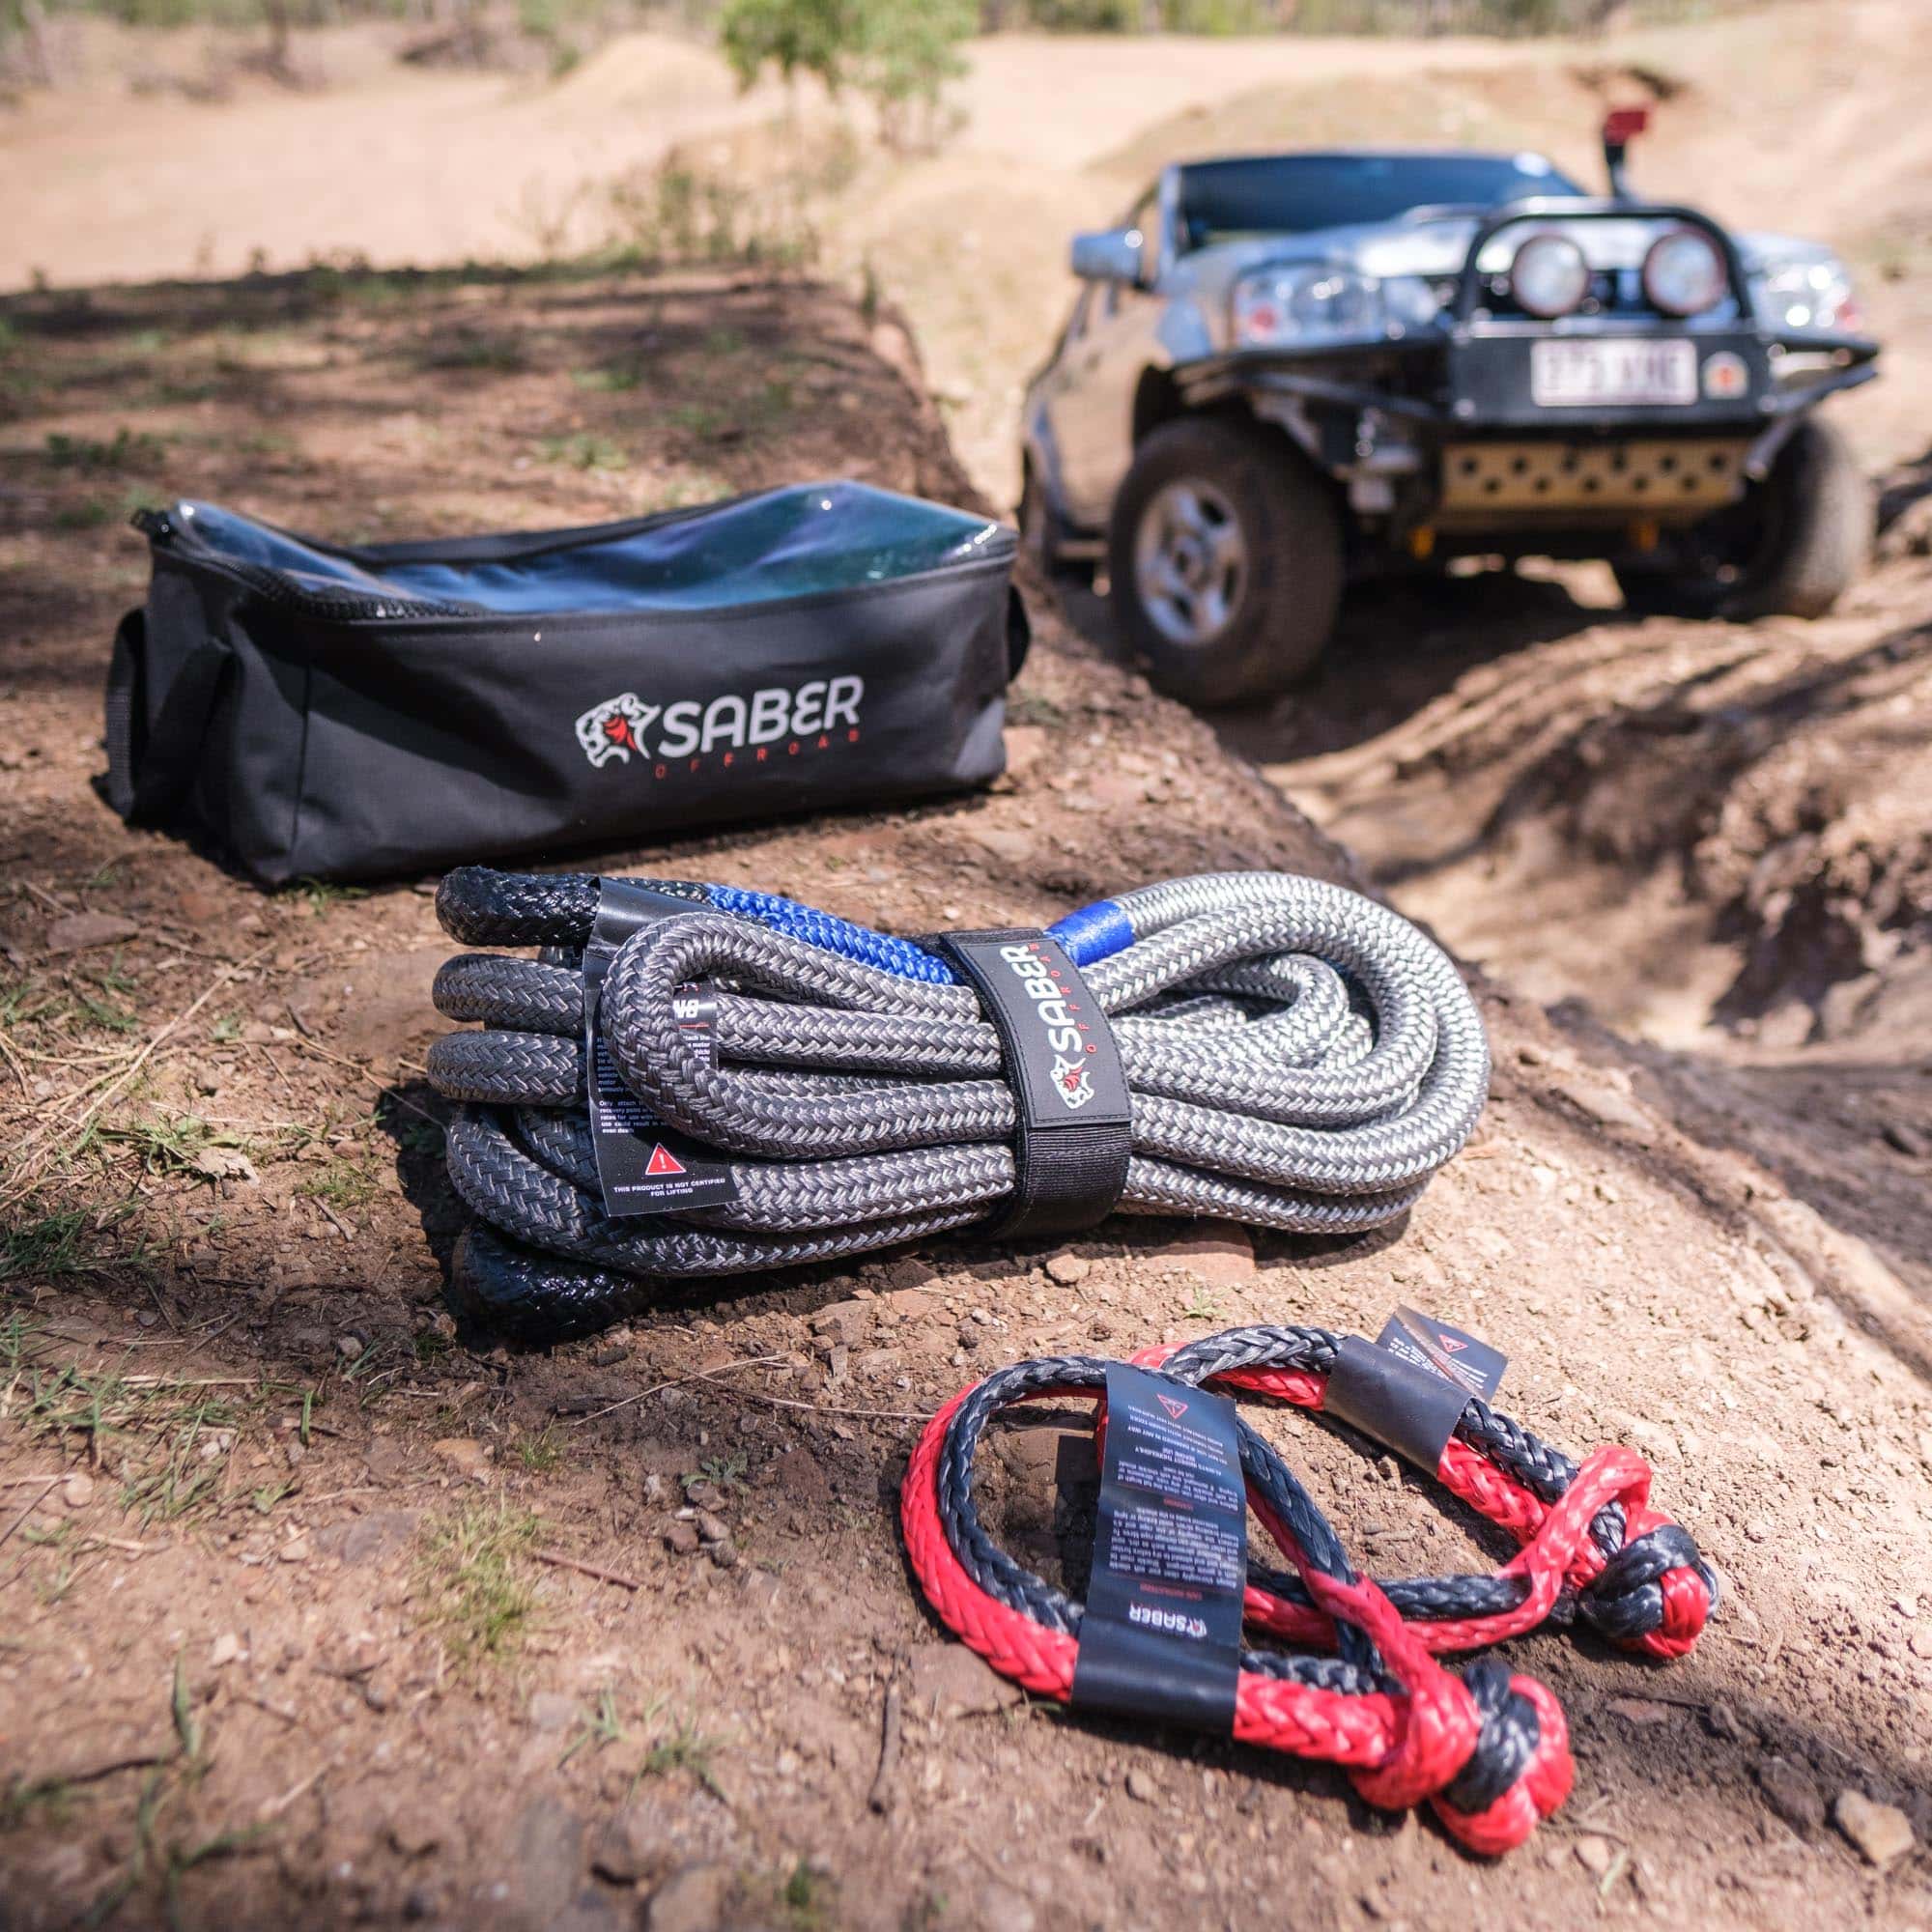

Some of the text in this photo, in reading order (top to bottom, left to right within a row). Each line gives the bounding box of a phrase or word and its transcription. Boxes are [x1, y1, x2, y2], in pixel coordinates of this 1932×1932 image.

[658, 674, 864, 758] SABER
[654, 728, 860, 780] OFFROAD
[1000, 945, 1082, 1053] SABER
[1028, 942, 1098, 1054] OFFROAD
[691, 1178, 725, 1186] CERTIFIED
[1129, 1604, 1187, 1633] SABER
